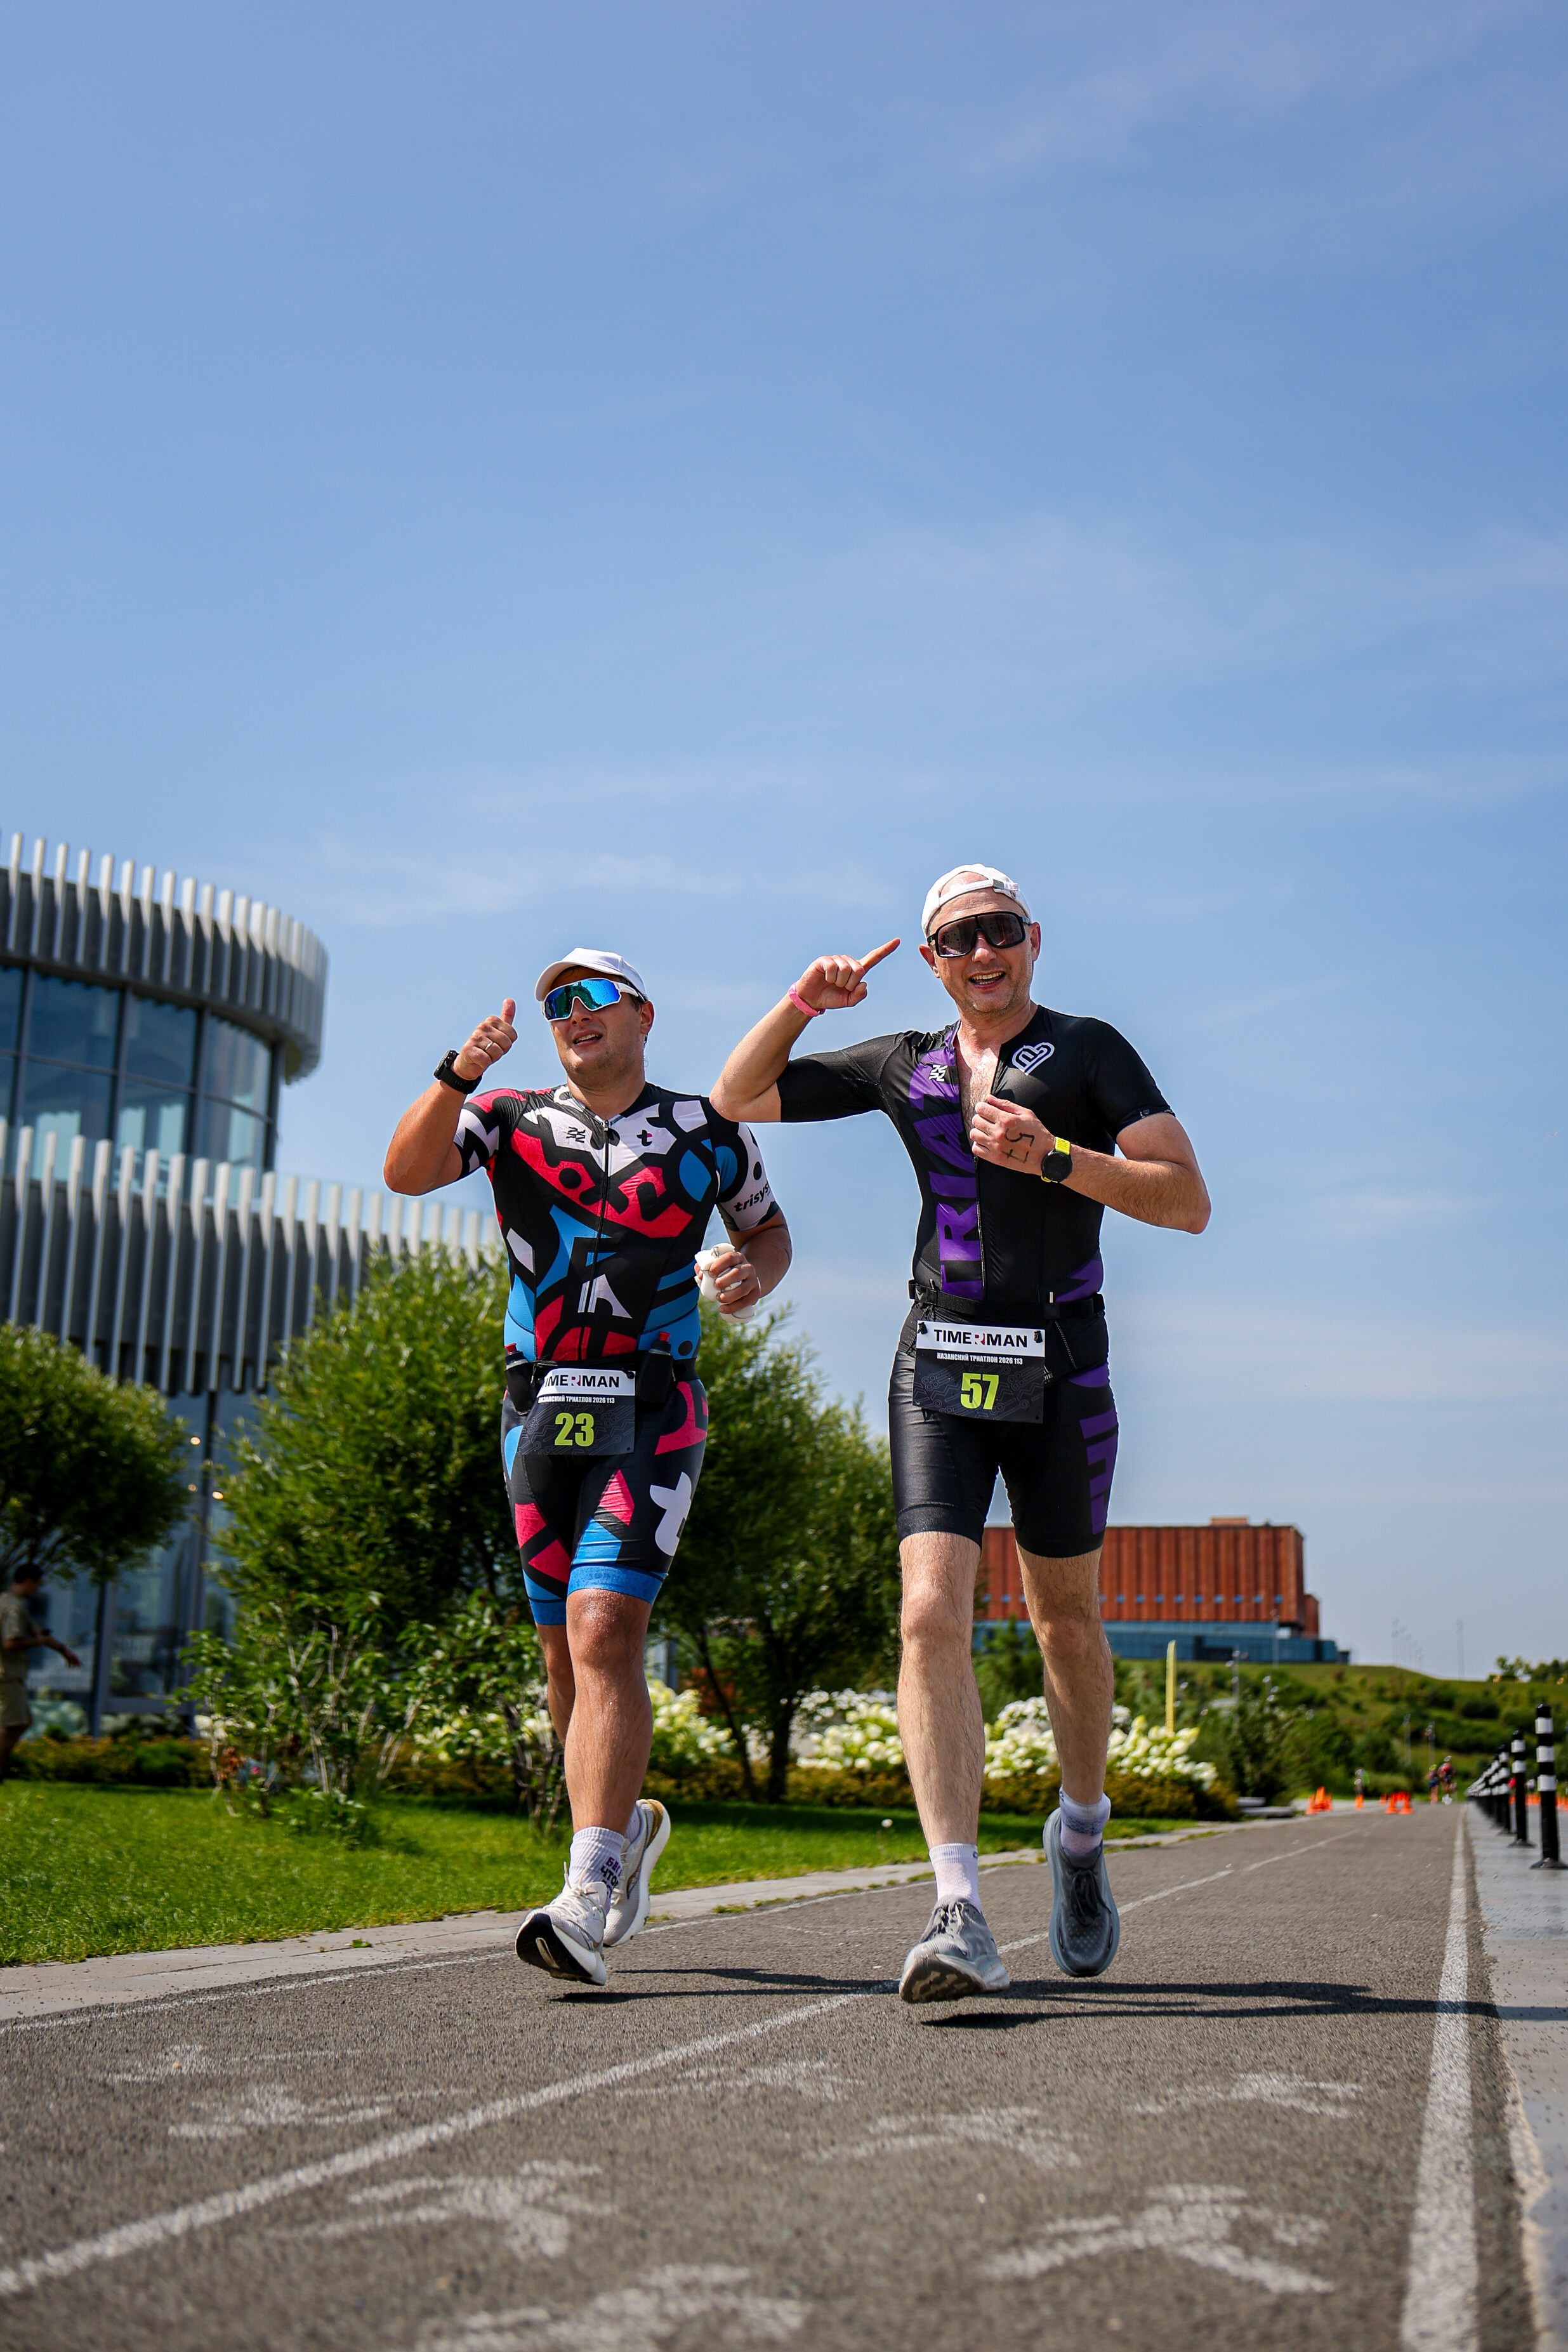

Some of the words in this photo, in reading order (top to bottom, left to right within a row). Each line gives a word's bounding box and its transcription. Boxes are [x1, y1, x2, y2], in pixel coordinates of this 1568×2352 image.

[1001, 1127, 1035, 1164] 57
[937, 1352, 969, 1361] КАЗАНСКИЙ
[969, 1354, 998, 1363] ТРИАТЛОН
[998, 1356, 1013, 1364] 2026
[543, 1374, 619, 1388] IMERMAN
[960, 1373, 999, 1410] 57
[555, 1412, 595, 1447] 23
